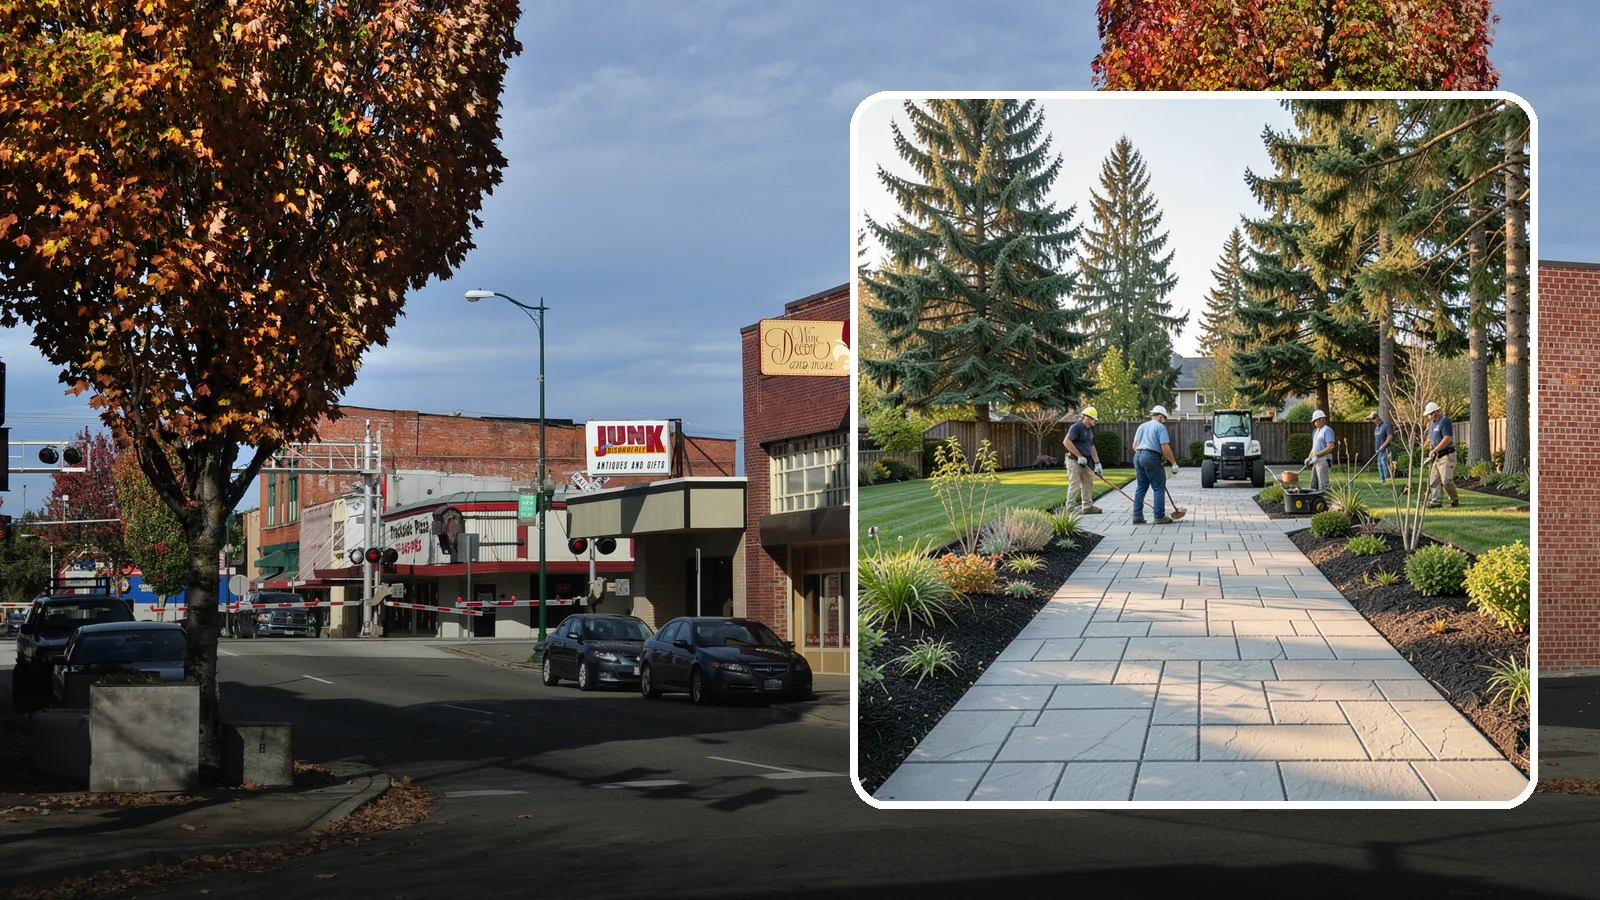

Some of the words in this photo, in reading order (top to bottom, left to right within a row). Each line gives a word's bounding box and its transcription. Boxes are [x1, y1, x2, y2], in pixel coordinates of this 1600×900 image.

[596, 425, 664, 457] JUNK
[607, 446, 646, 454] DISORDERLY
[597, 461, 628, 470] ANTIQUES
[631, 461, 644, 470] AND
[647, 460, 665, 470] GIFTS
